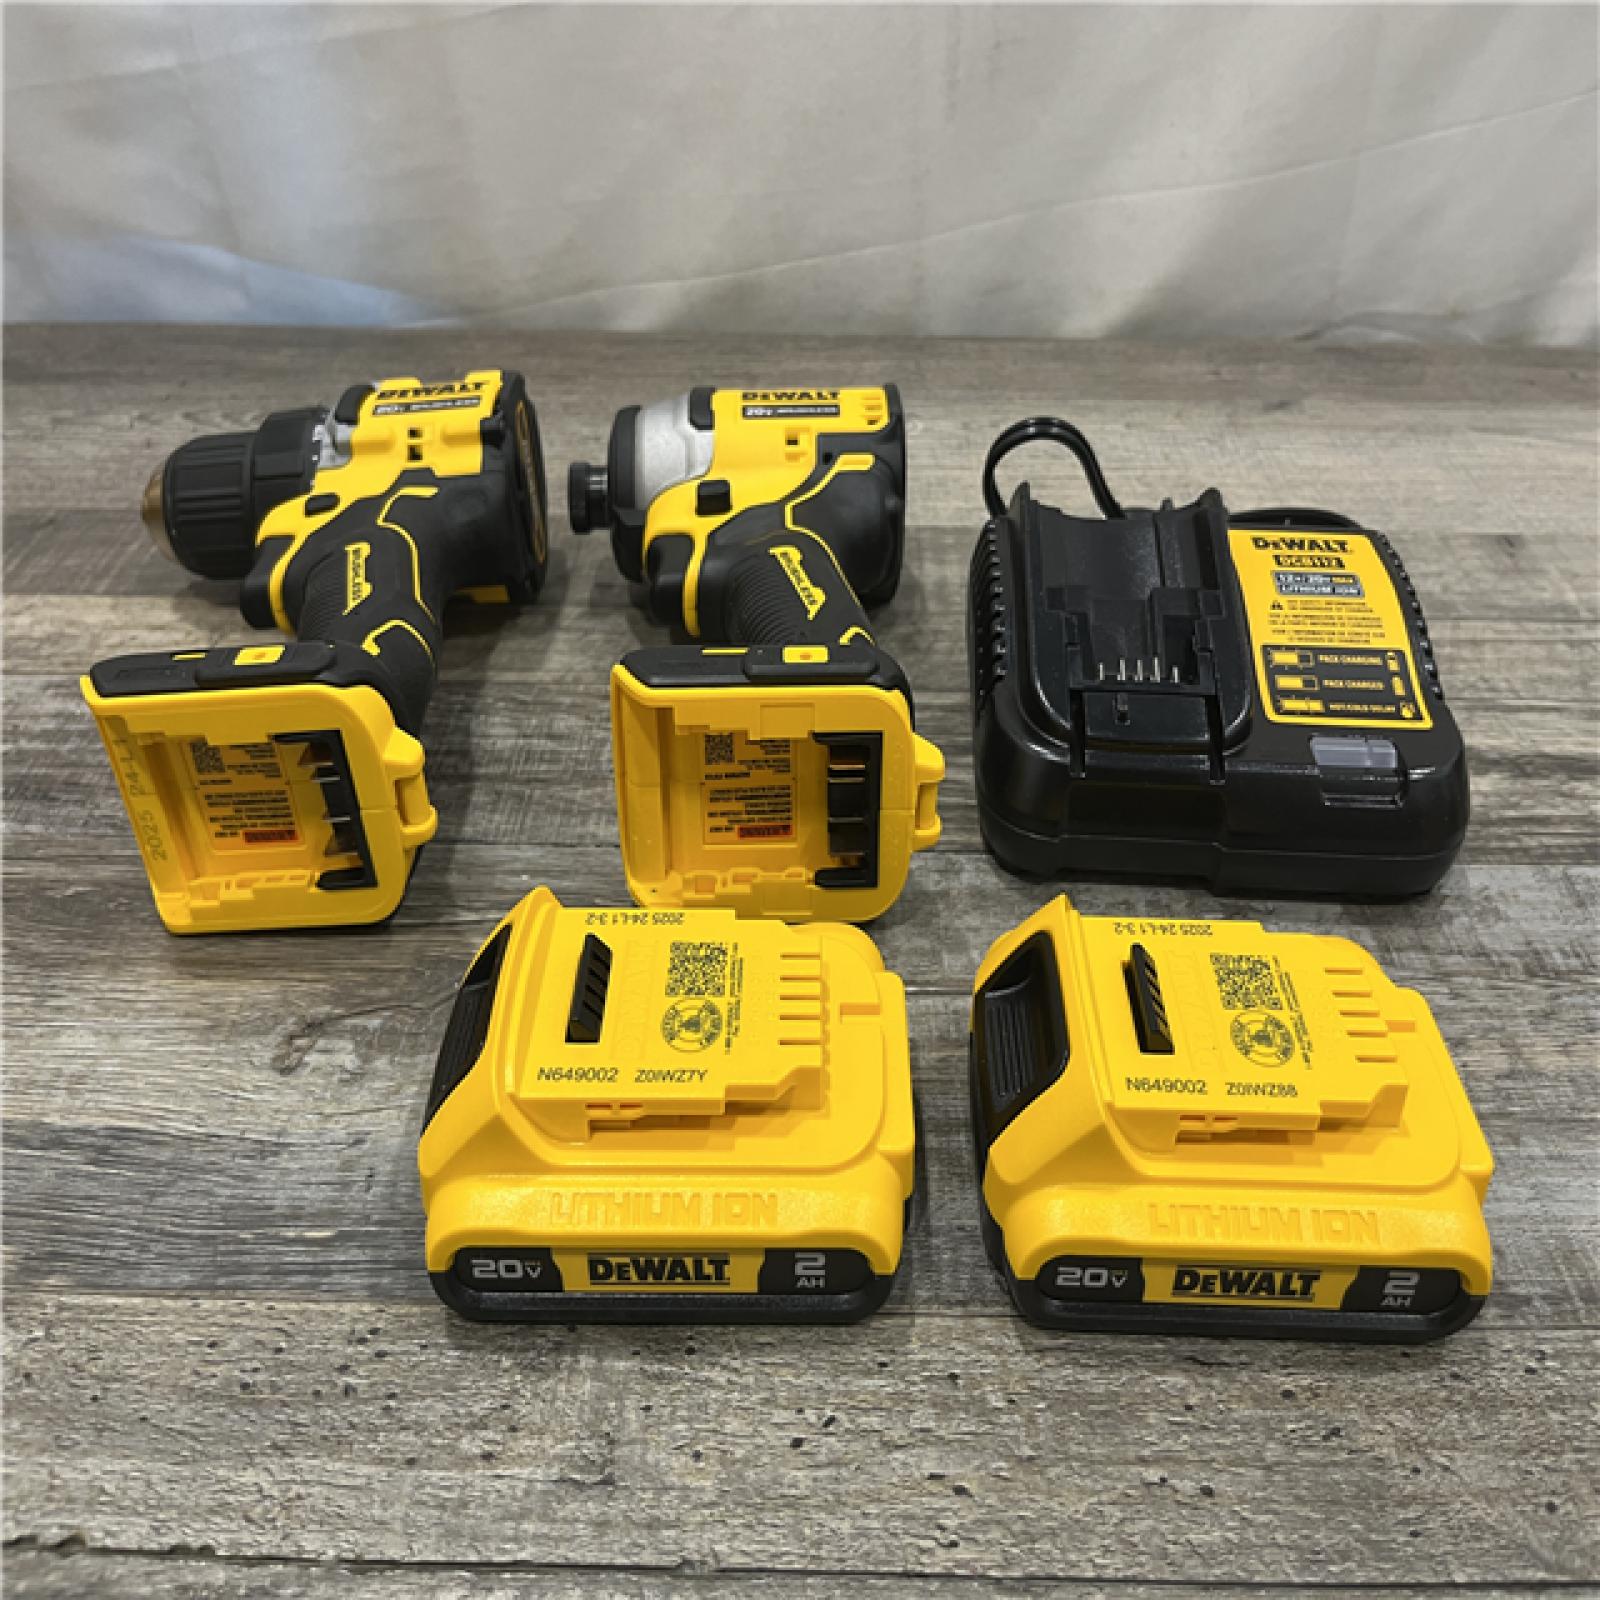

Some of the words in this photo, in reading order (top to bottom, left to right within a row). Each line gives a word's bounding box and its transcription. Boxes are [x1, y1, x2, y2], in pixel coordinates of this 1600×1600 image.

[376, 382, 482, 400] DEWALT
[741, 391, 840, 401] DEWALT
[1252, 536, 1350, 553] DEWALT
[537, 1066, 619, 1083] N649002
[1125, 1076, 1208, 1095] N649002
[550, 1191, 701, 1226] LITHIUM
[713, 1191, 778, 1226] ION
[1149, 1203, 1301, 1241] LITHIUM
[1311, 1210, 1380, 1244] ION
[588, 1256, 730, 1282] DEWALT
[794, 1252, 826, 1276] 2
[1172, 1269, 1320, 1297] DEWALT
[1384, 1272, 1419, 1296] 2
